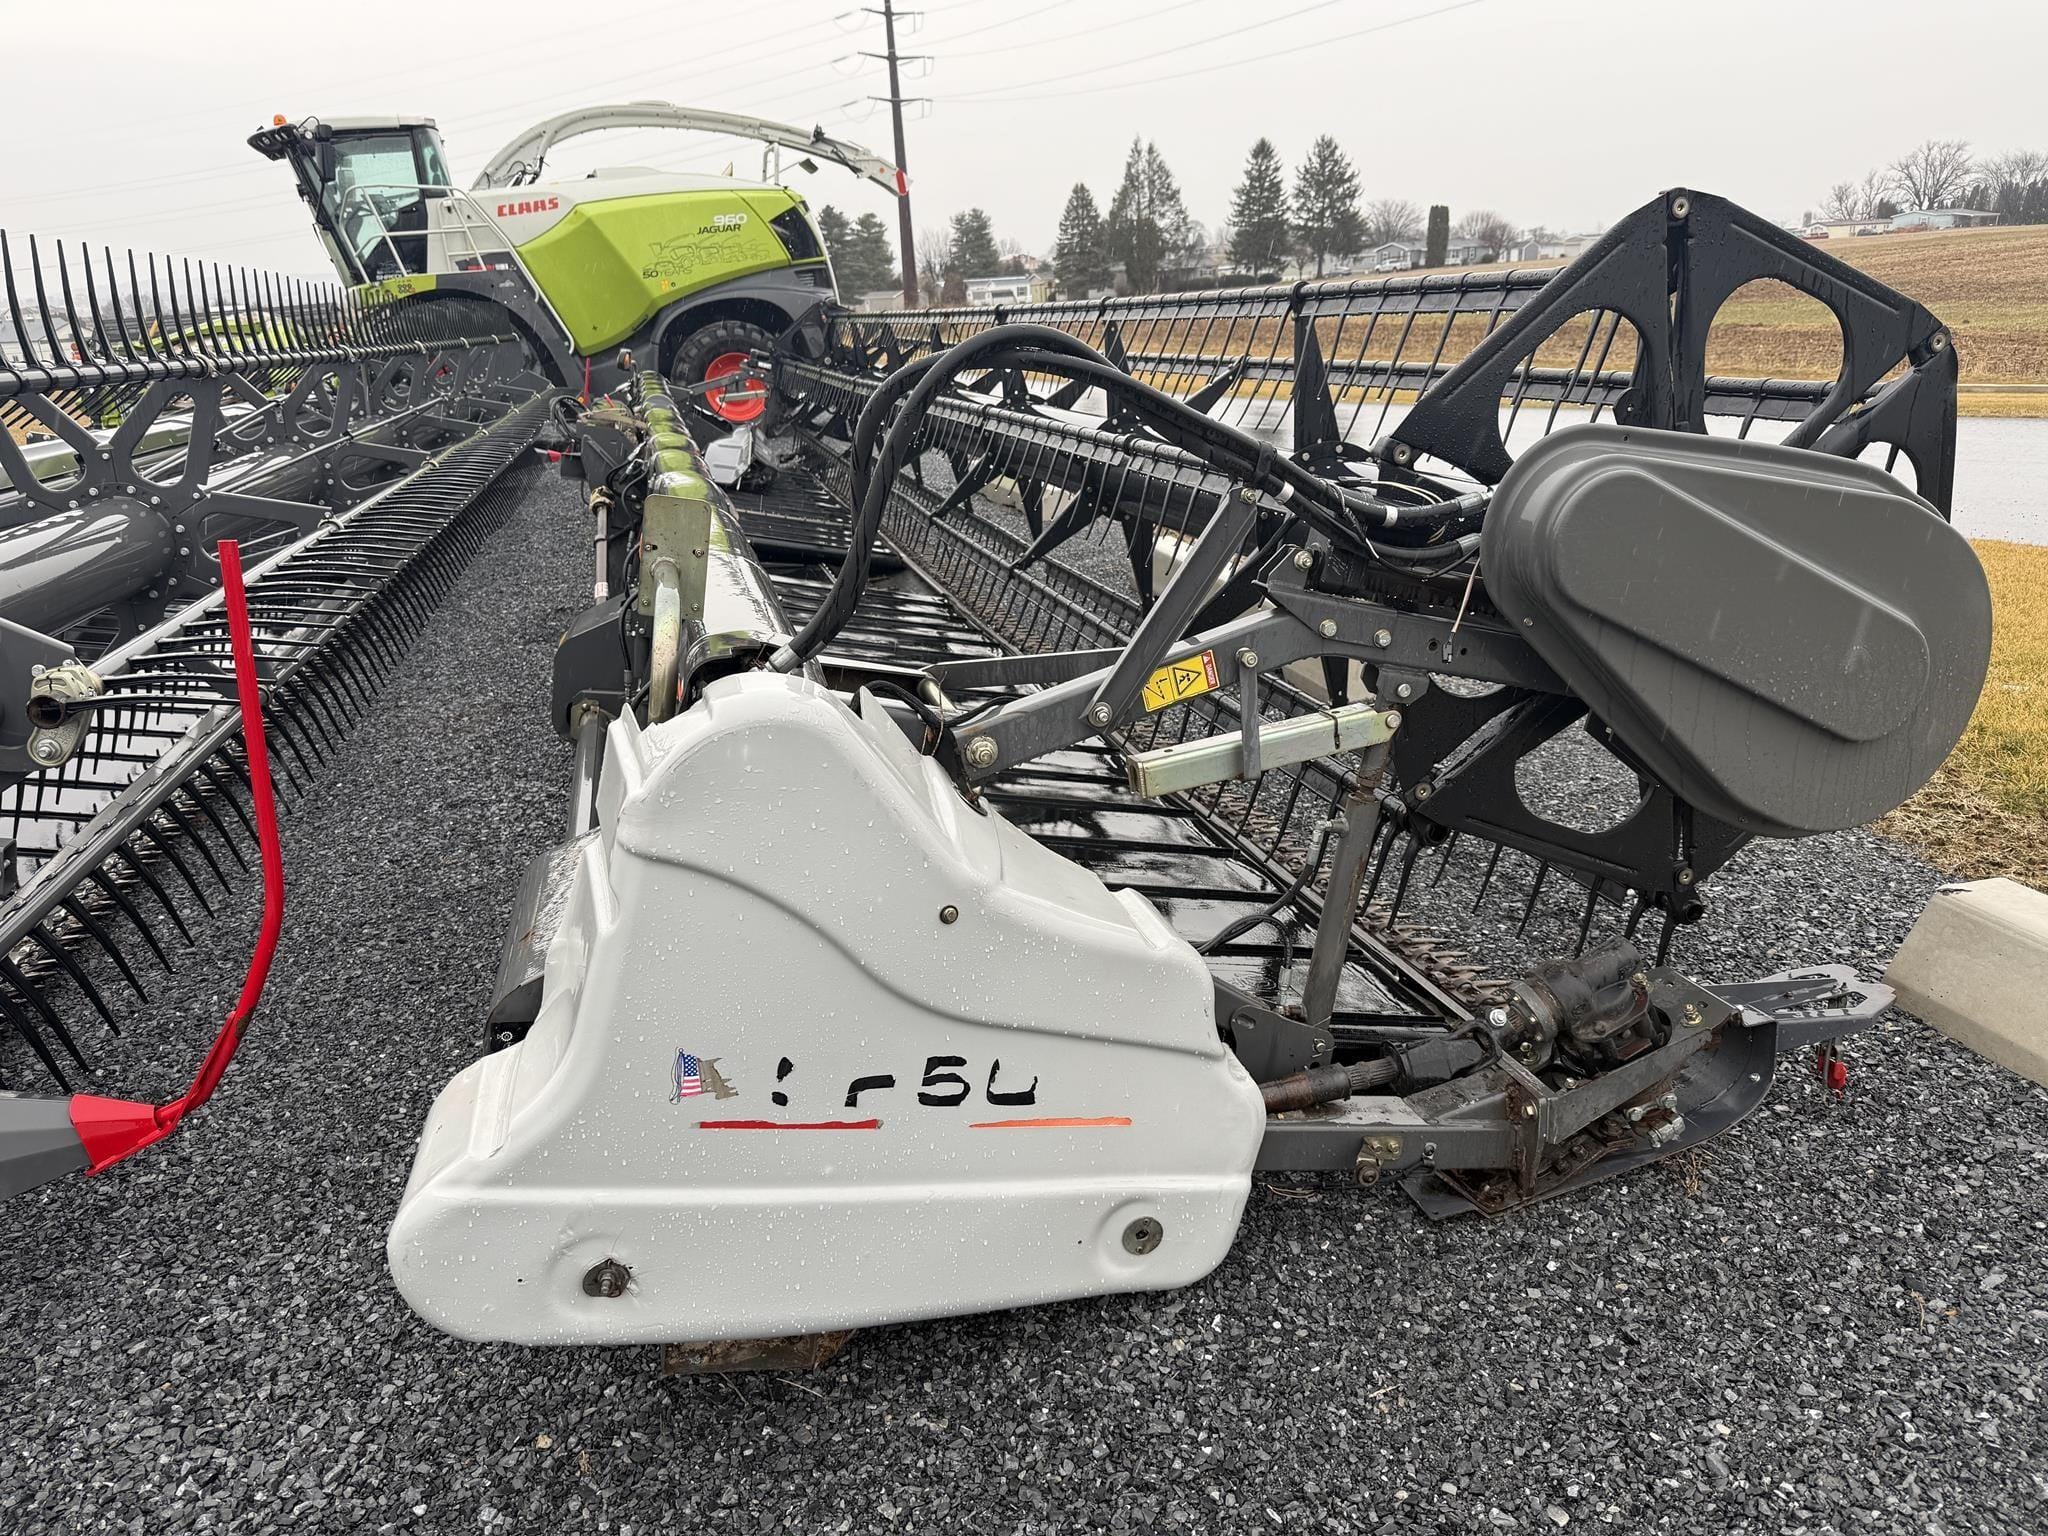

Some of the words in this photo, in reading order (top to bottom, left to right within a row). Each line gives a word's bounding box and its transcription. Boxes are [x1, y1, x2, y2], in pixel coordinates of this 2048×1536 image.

[497, 197, 559, 217] CLAAS
[713, 213, 748, 226] 960
[697, 223, 742, 235] JAGUAR
[642, 270, 659, 279] 50
